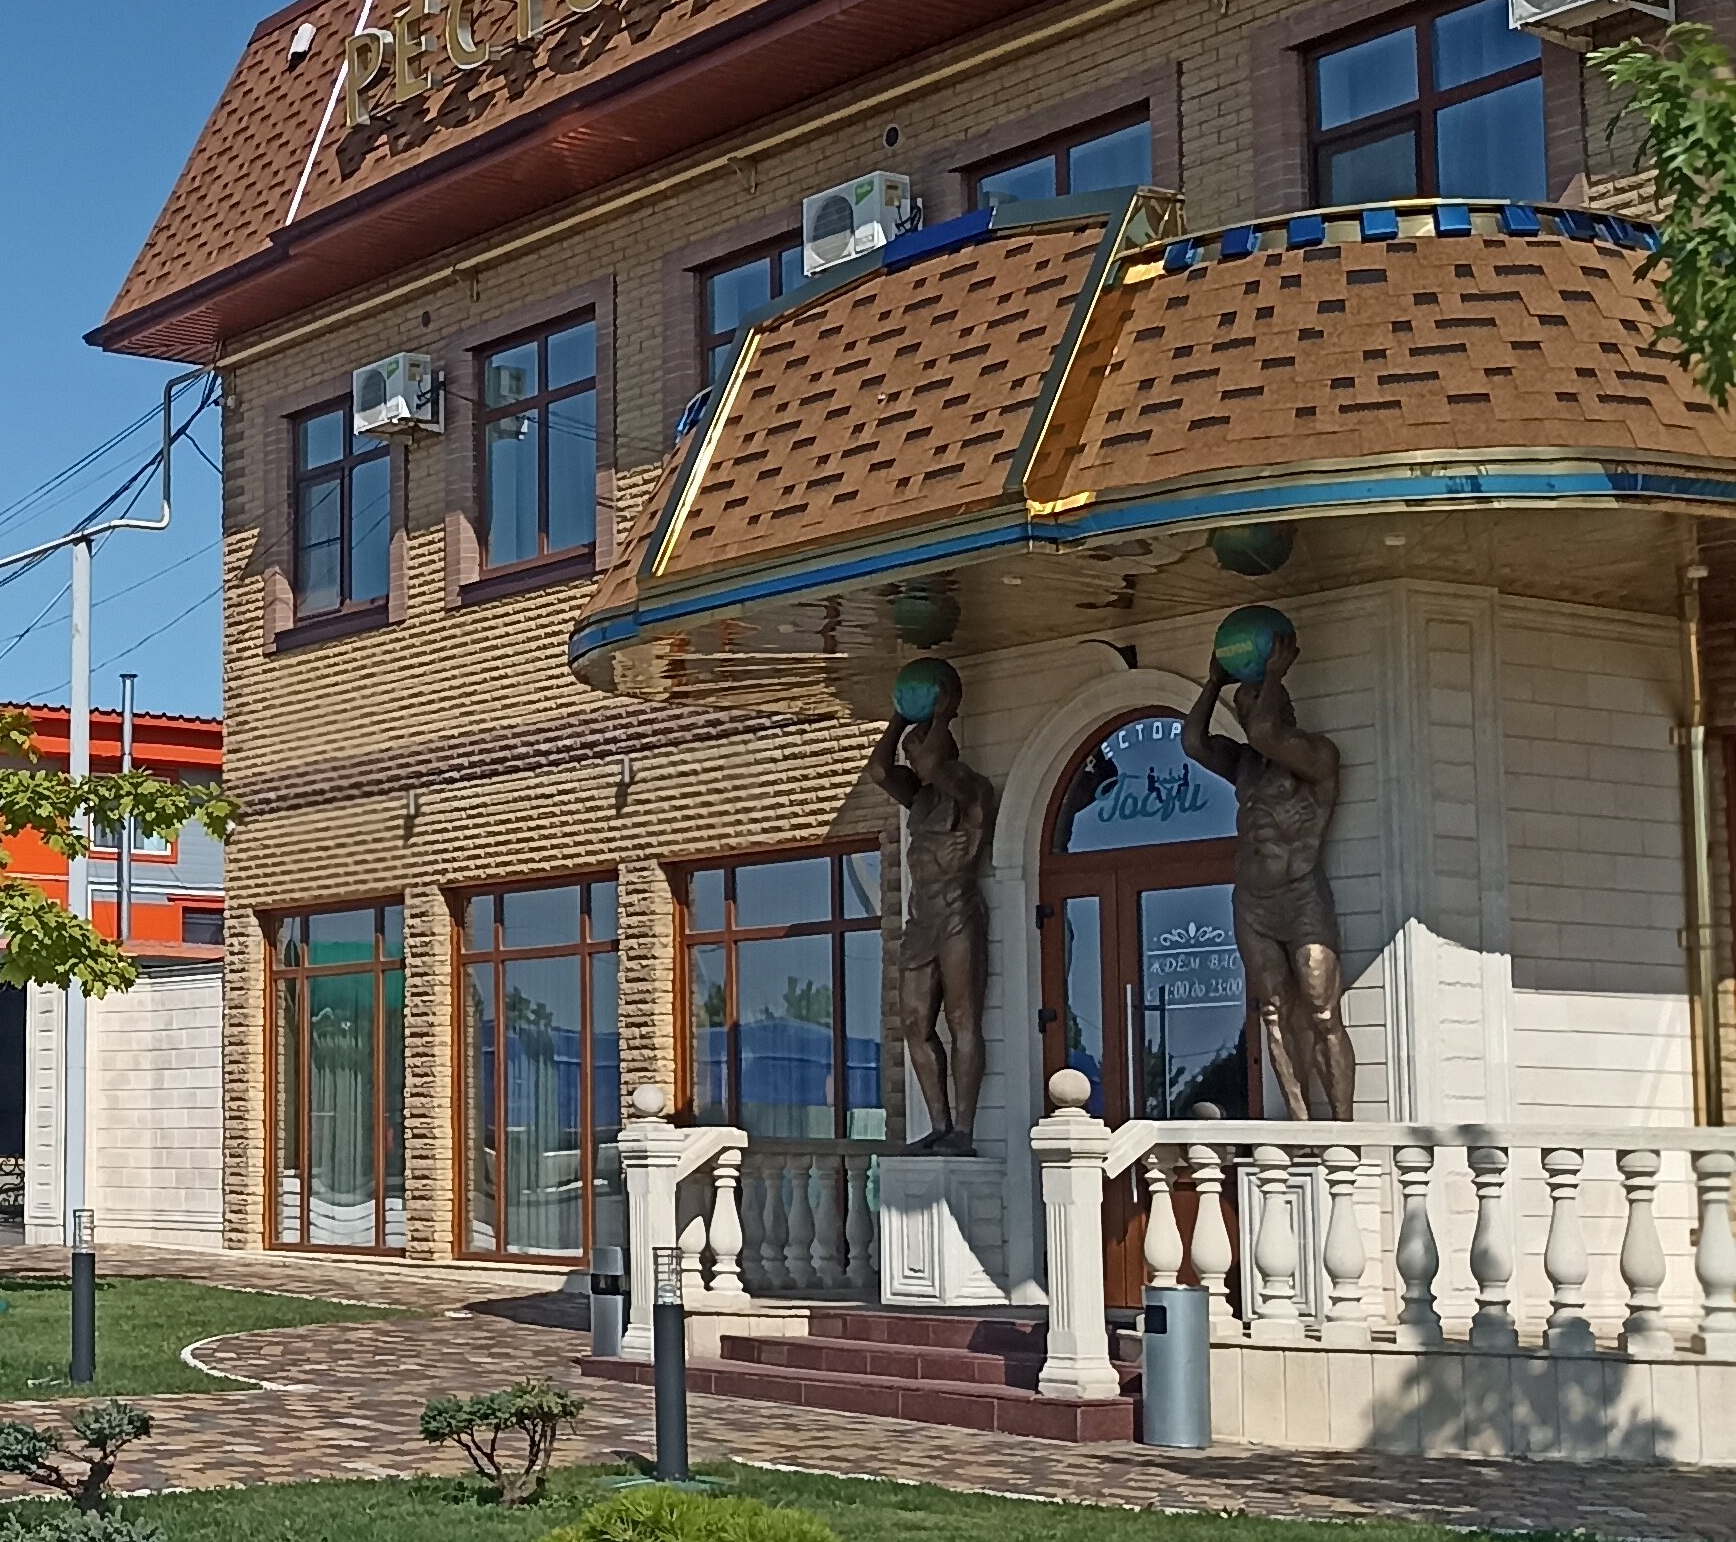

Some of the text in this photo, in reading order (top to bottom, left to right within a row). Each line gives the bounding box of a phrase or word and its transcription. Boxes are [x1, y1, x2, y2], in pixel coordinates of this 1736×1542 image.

[1084, 721, 1183, 774] РЕСТОР
[1206, 952, 1241, 970] ВАС
[1208, 978, 1244, 997] 23:00
